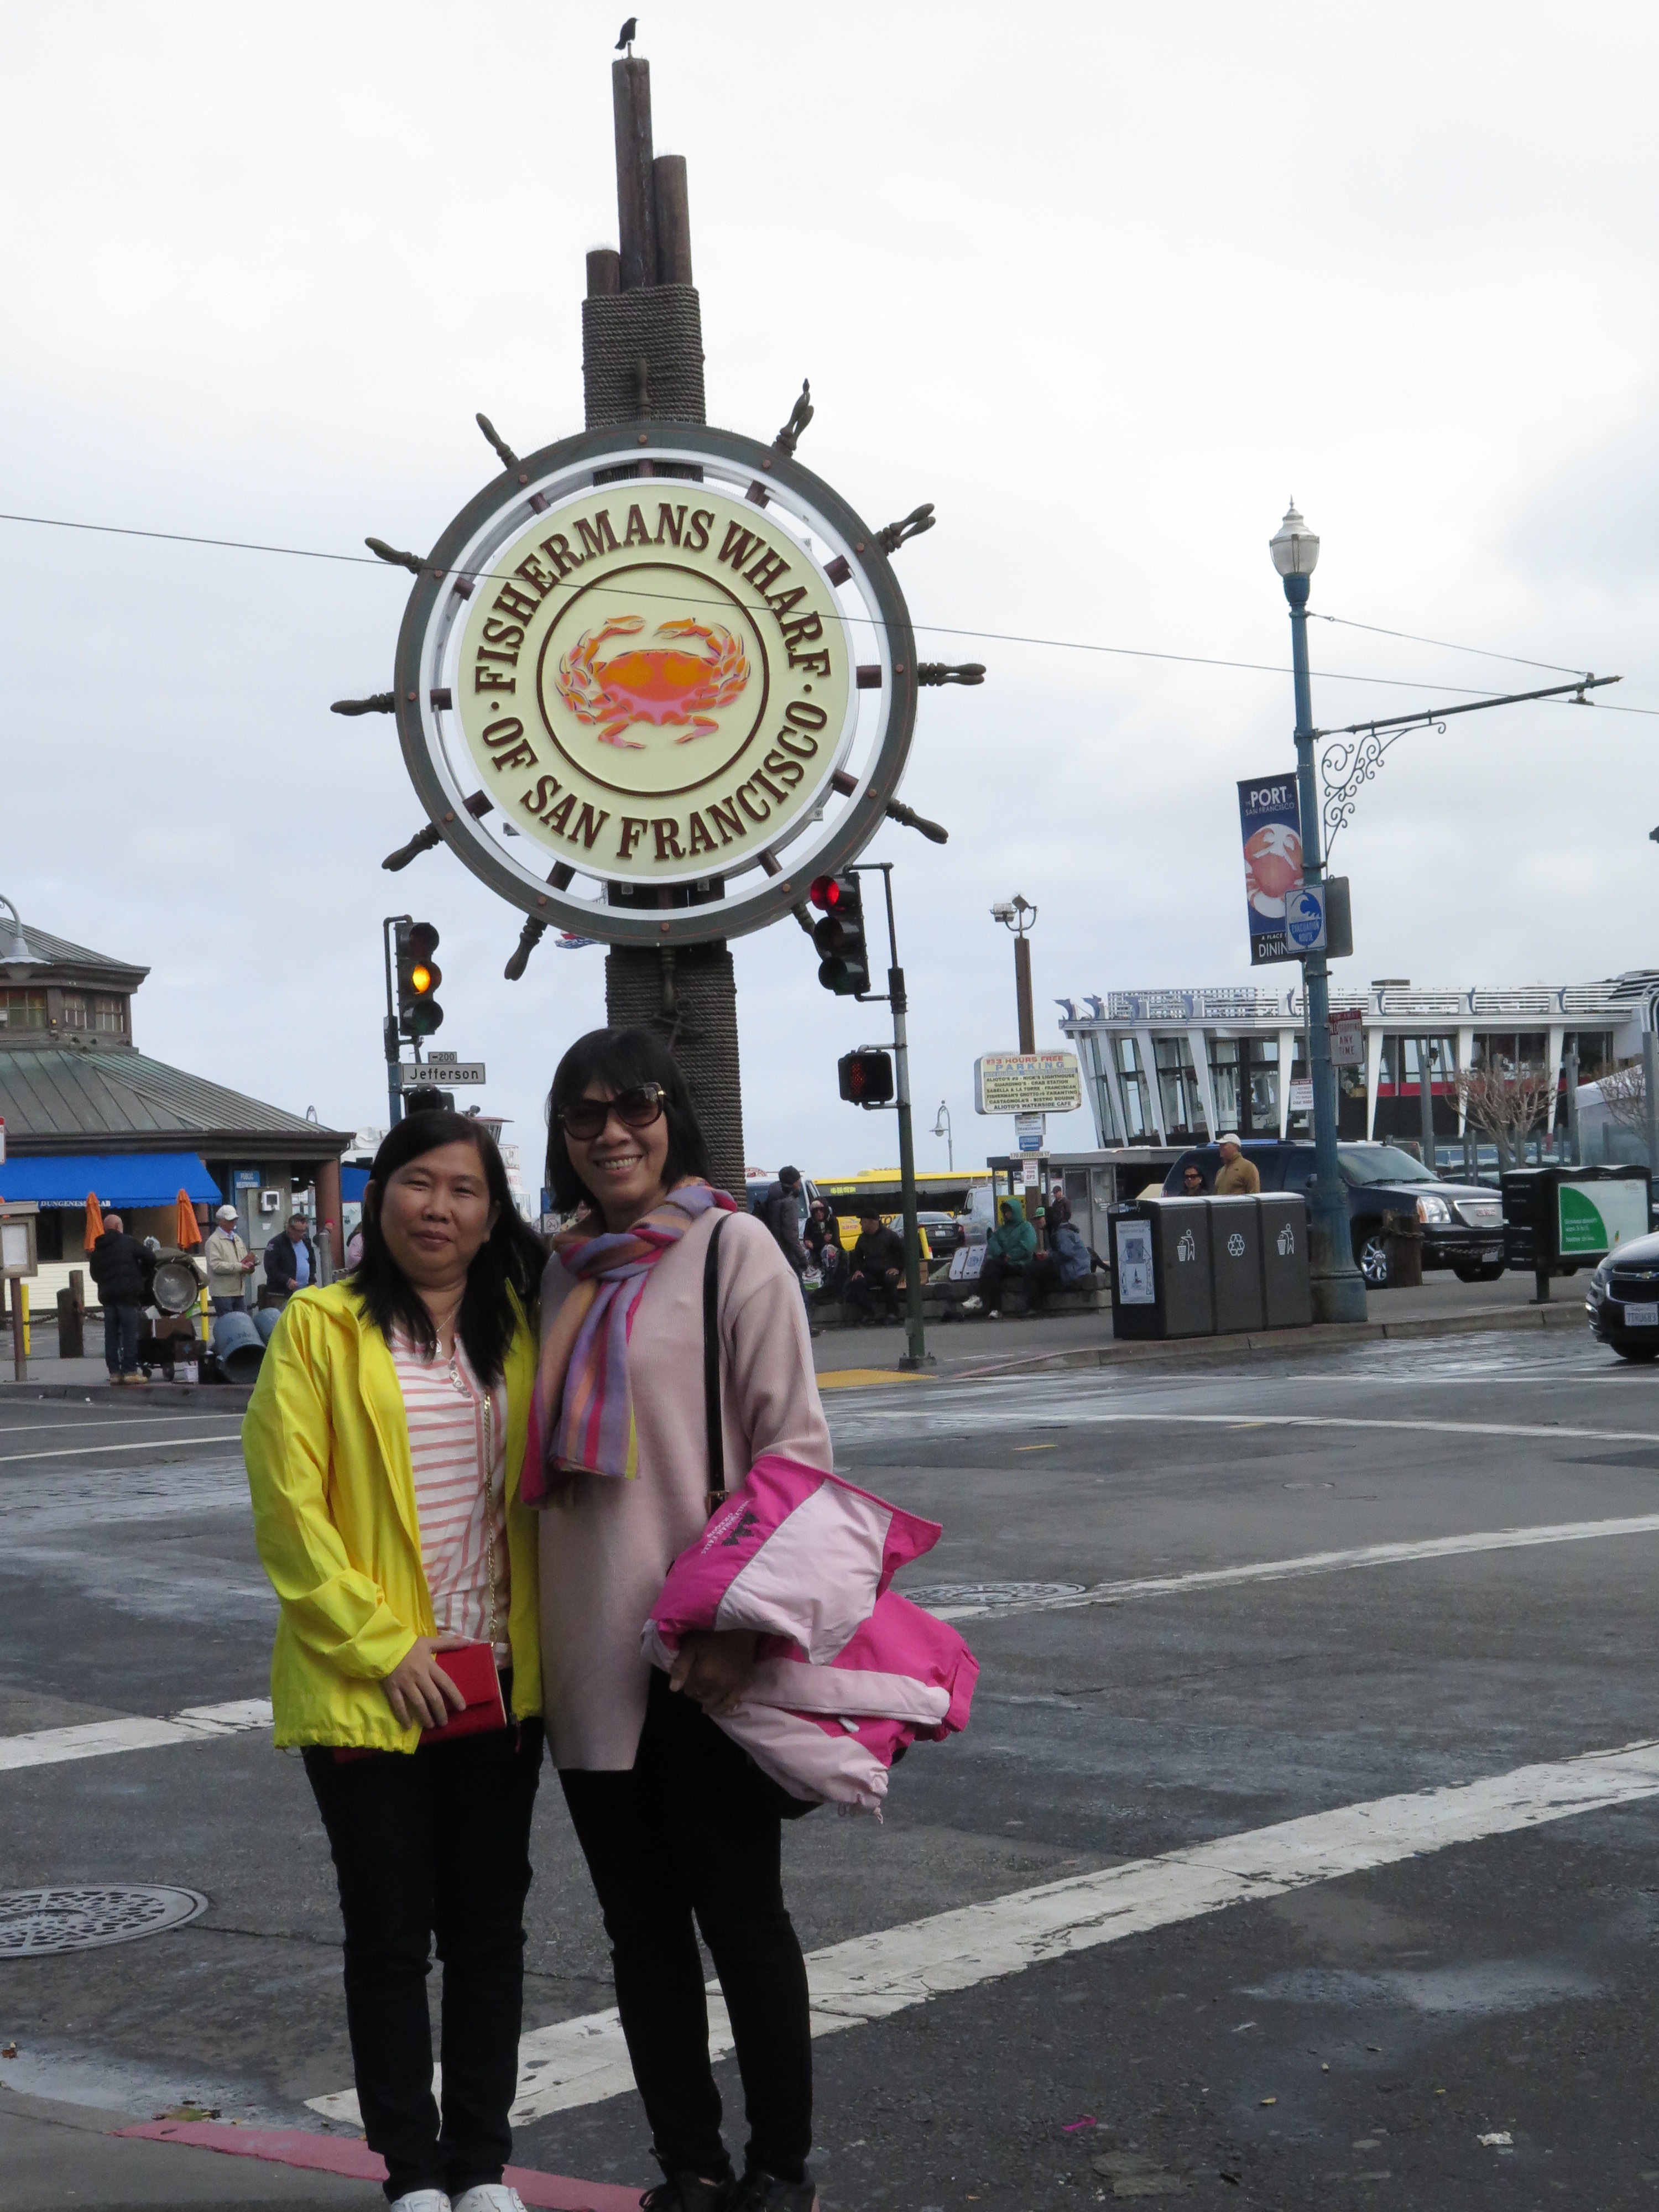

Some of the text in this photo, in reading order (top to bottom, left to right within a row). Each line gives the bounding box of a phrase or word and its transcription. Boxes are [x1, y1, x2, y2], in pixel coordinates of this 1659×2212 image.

[475, 502, 832, 695] FISHERMANS WHARF
[482, 700, 828, 861] OF SAN FRANCISCO
[1250, 785, 1287, 808] PORT
[1245, 802, 1295, 816] SAN FRANCISCO
[1258, 941, 1288, 957] DININ
[1340, 1036, 1353, 1045] ANY
[1339, 1045, 1354, 1055] TIME
[439, 1053, 455, 1061] 200
[995, 1061, 1065, 1071] PARKING
[410, 1068, 478, 1080] Jefferson
